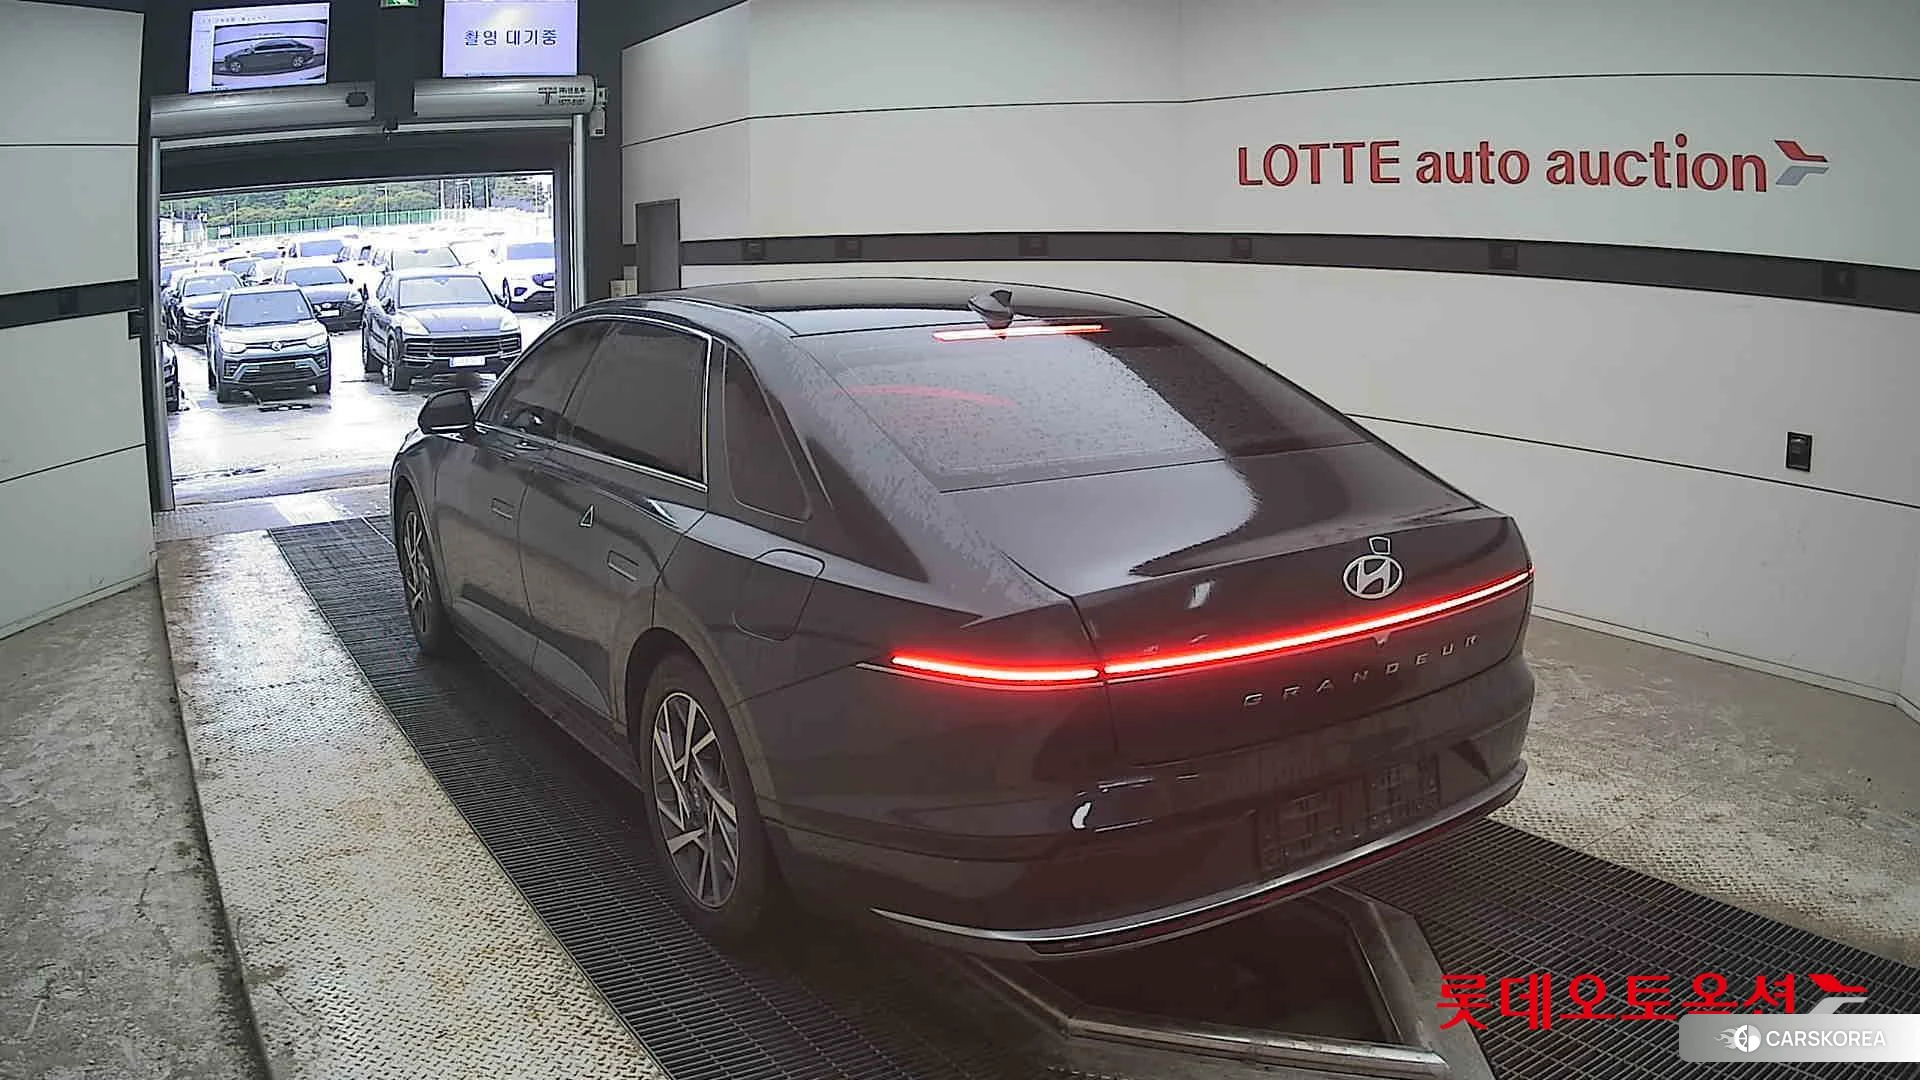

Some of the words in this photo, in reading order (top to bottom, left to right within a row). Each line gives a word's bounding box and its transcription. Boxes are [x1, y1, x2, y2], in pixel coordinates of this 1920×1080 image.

[506, 29, 558, 46] 대기중
[1238, 140, 1401, 187] LOTTE
[1415, 141, 1530, 185] auto
[1546, 133, 1767, 193] auction
[1243, 634, 1479, 707] GRANDEUR
